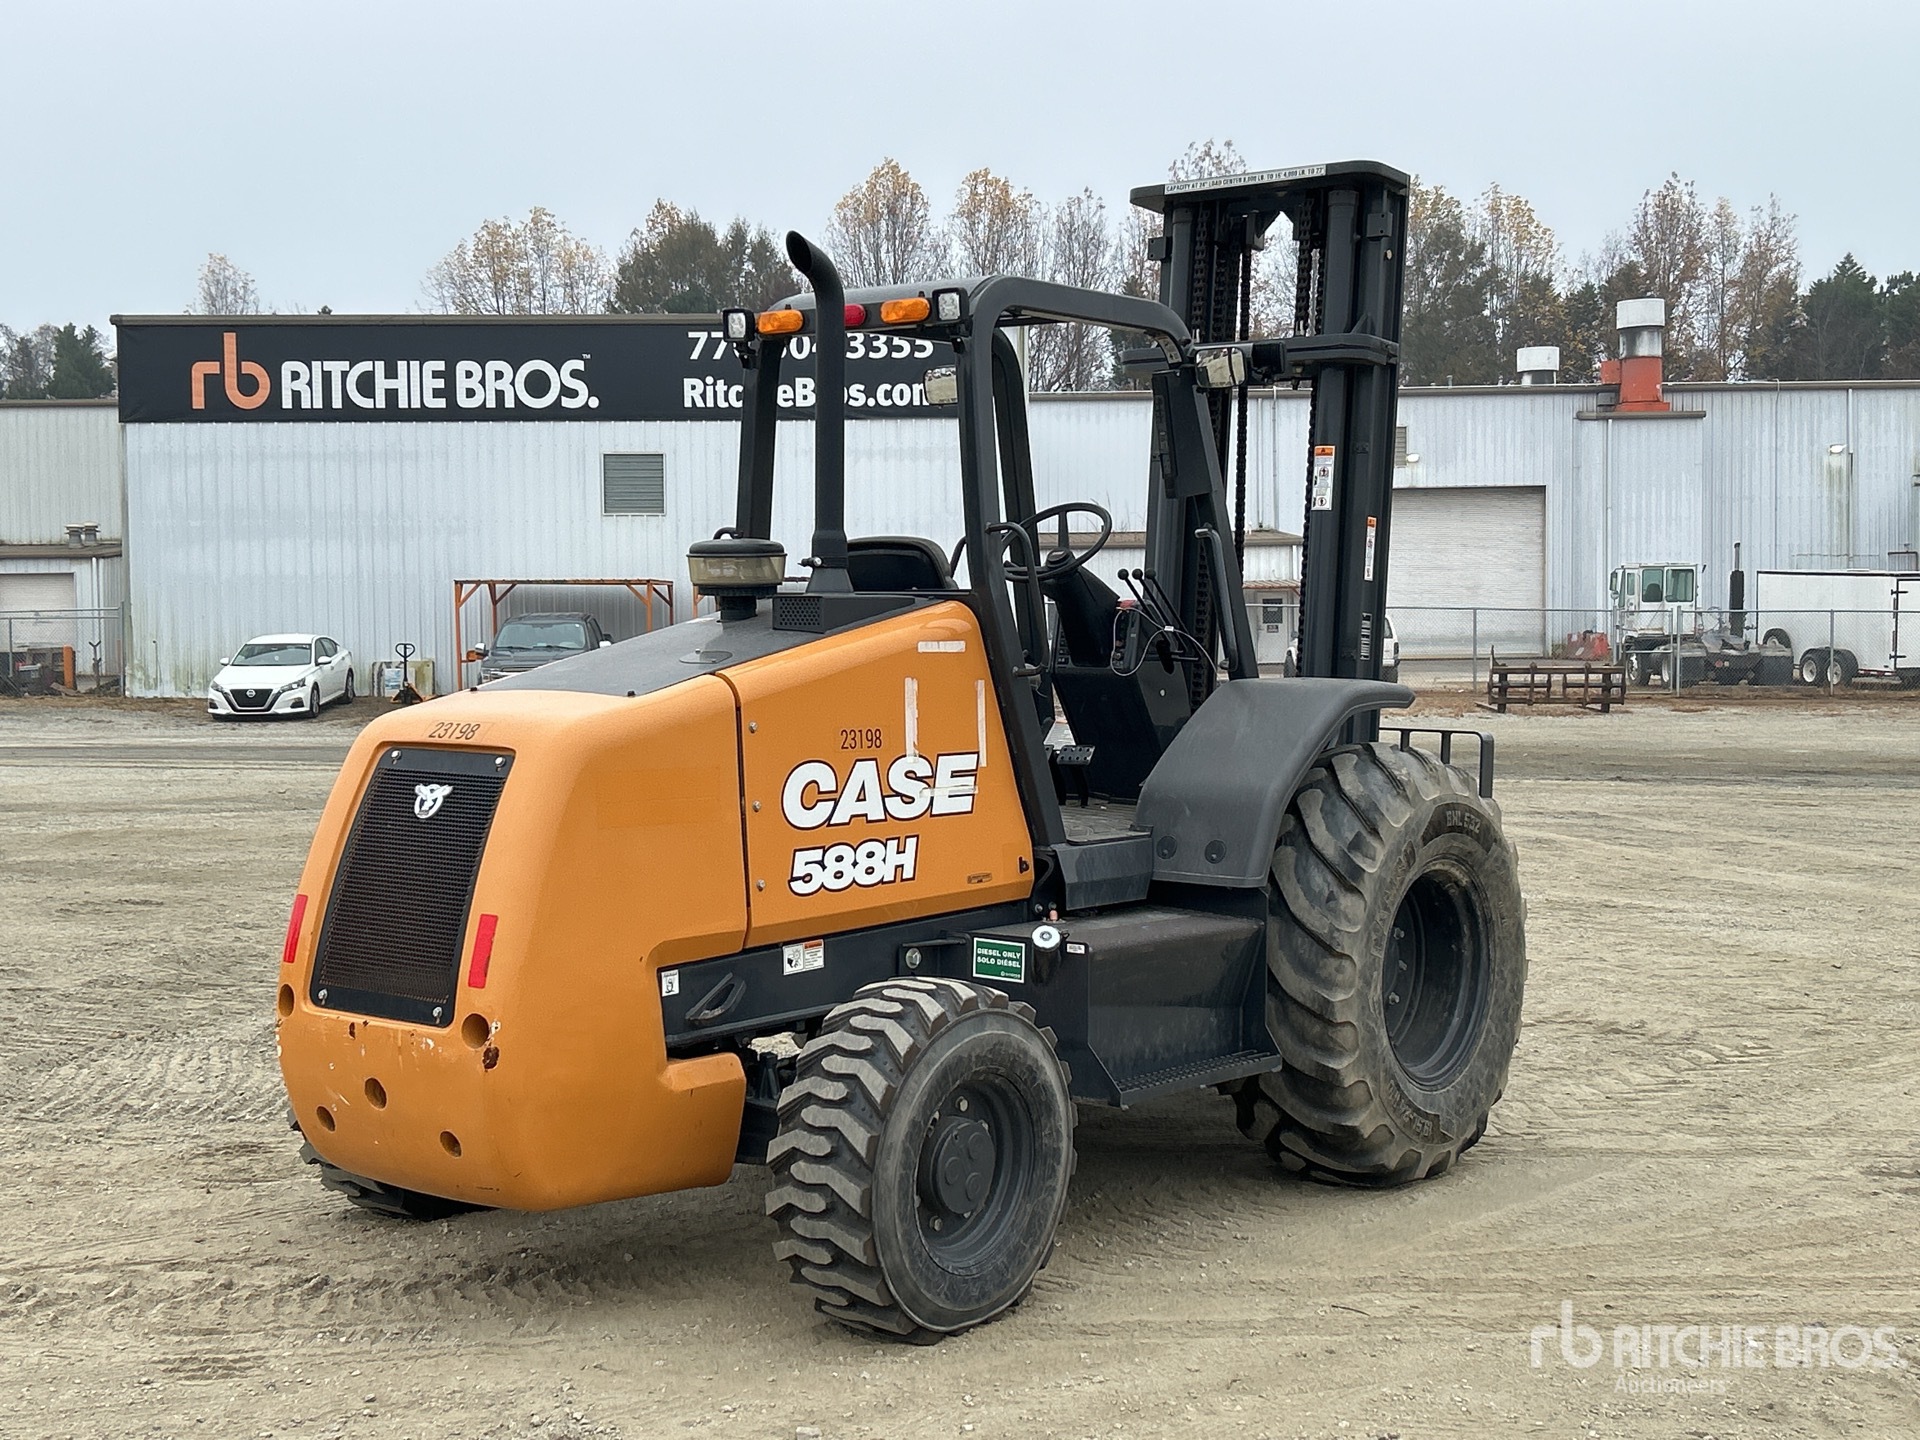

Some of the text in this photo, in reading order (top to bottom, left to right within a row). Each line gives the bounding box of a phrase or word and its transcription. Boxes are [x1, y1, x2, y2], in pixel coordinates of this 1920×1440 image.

[1166, 183, 1190, 192] CAPACITY
[1208, 179, 1222, 187] LOAD
[1222, 177, 1242, 185] CENTER
[191, 332, 271, 410] rb
[281, 360, 447, 410] RITCHIE
[455, 359, 600, 410] BROS.
[428, 722, 481, 740] 23198
[840, 728, 883, 751] 23198
[781, 751, 980, 831] CASE
[788, 834, 919, 897] 588H
[976, 948, 1021, 959] DIESEL ONLY
[976, 956, 996, 965] SOLO
